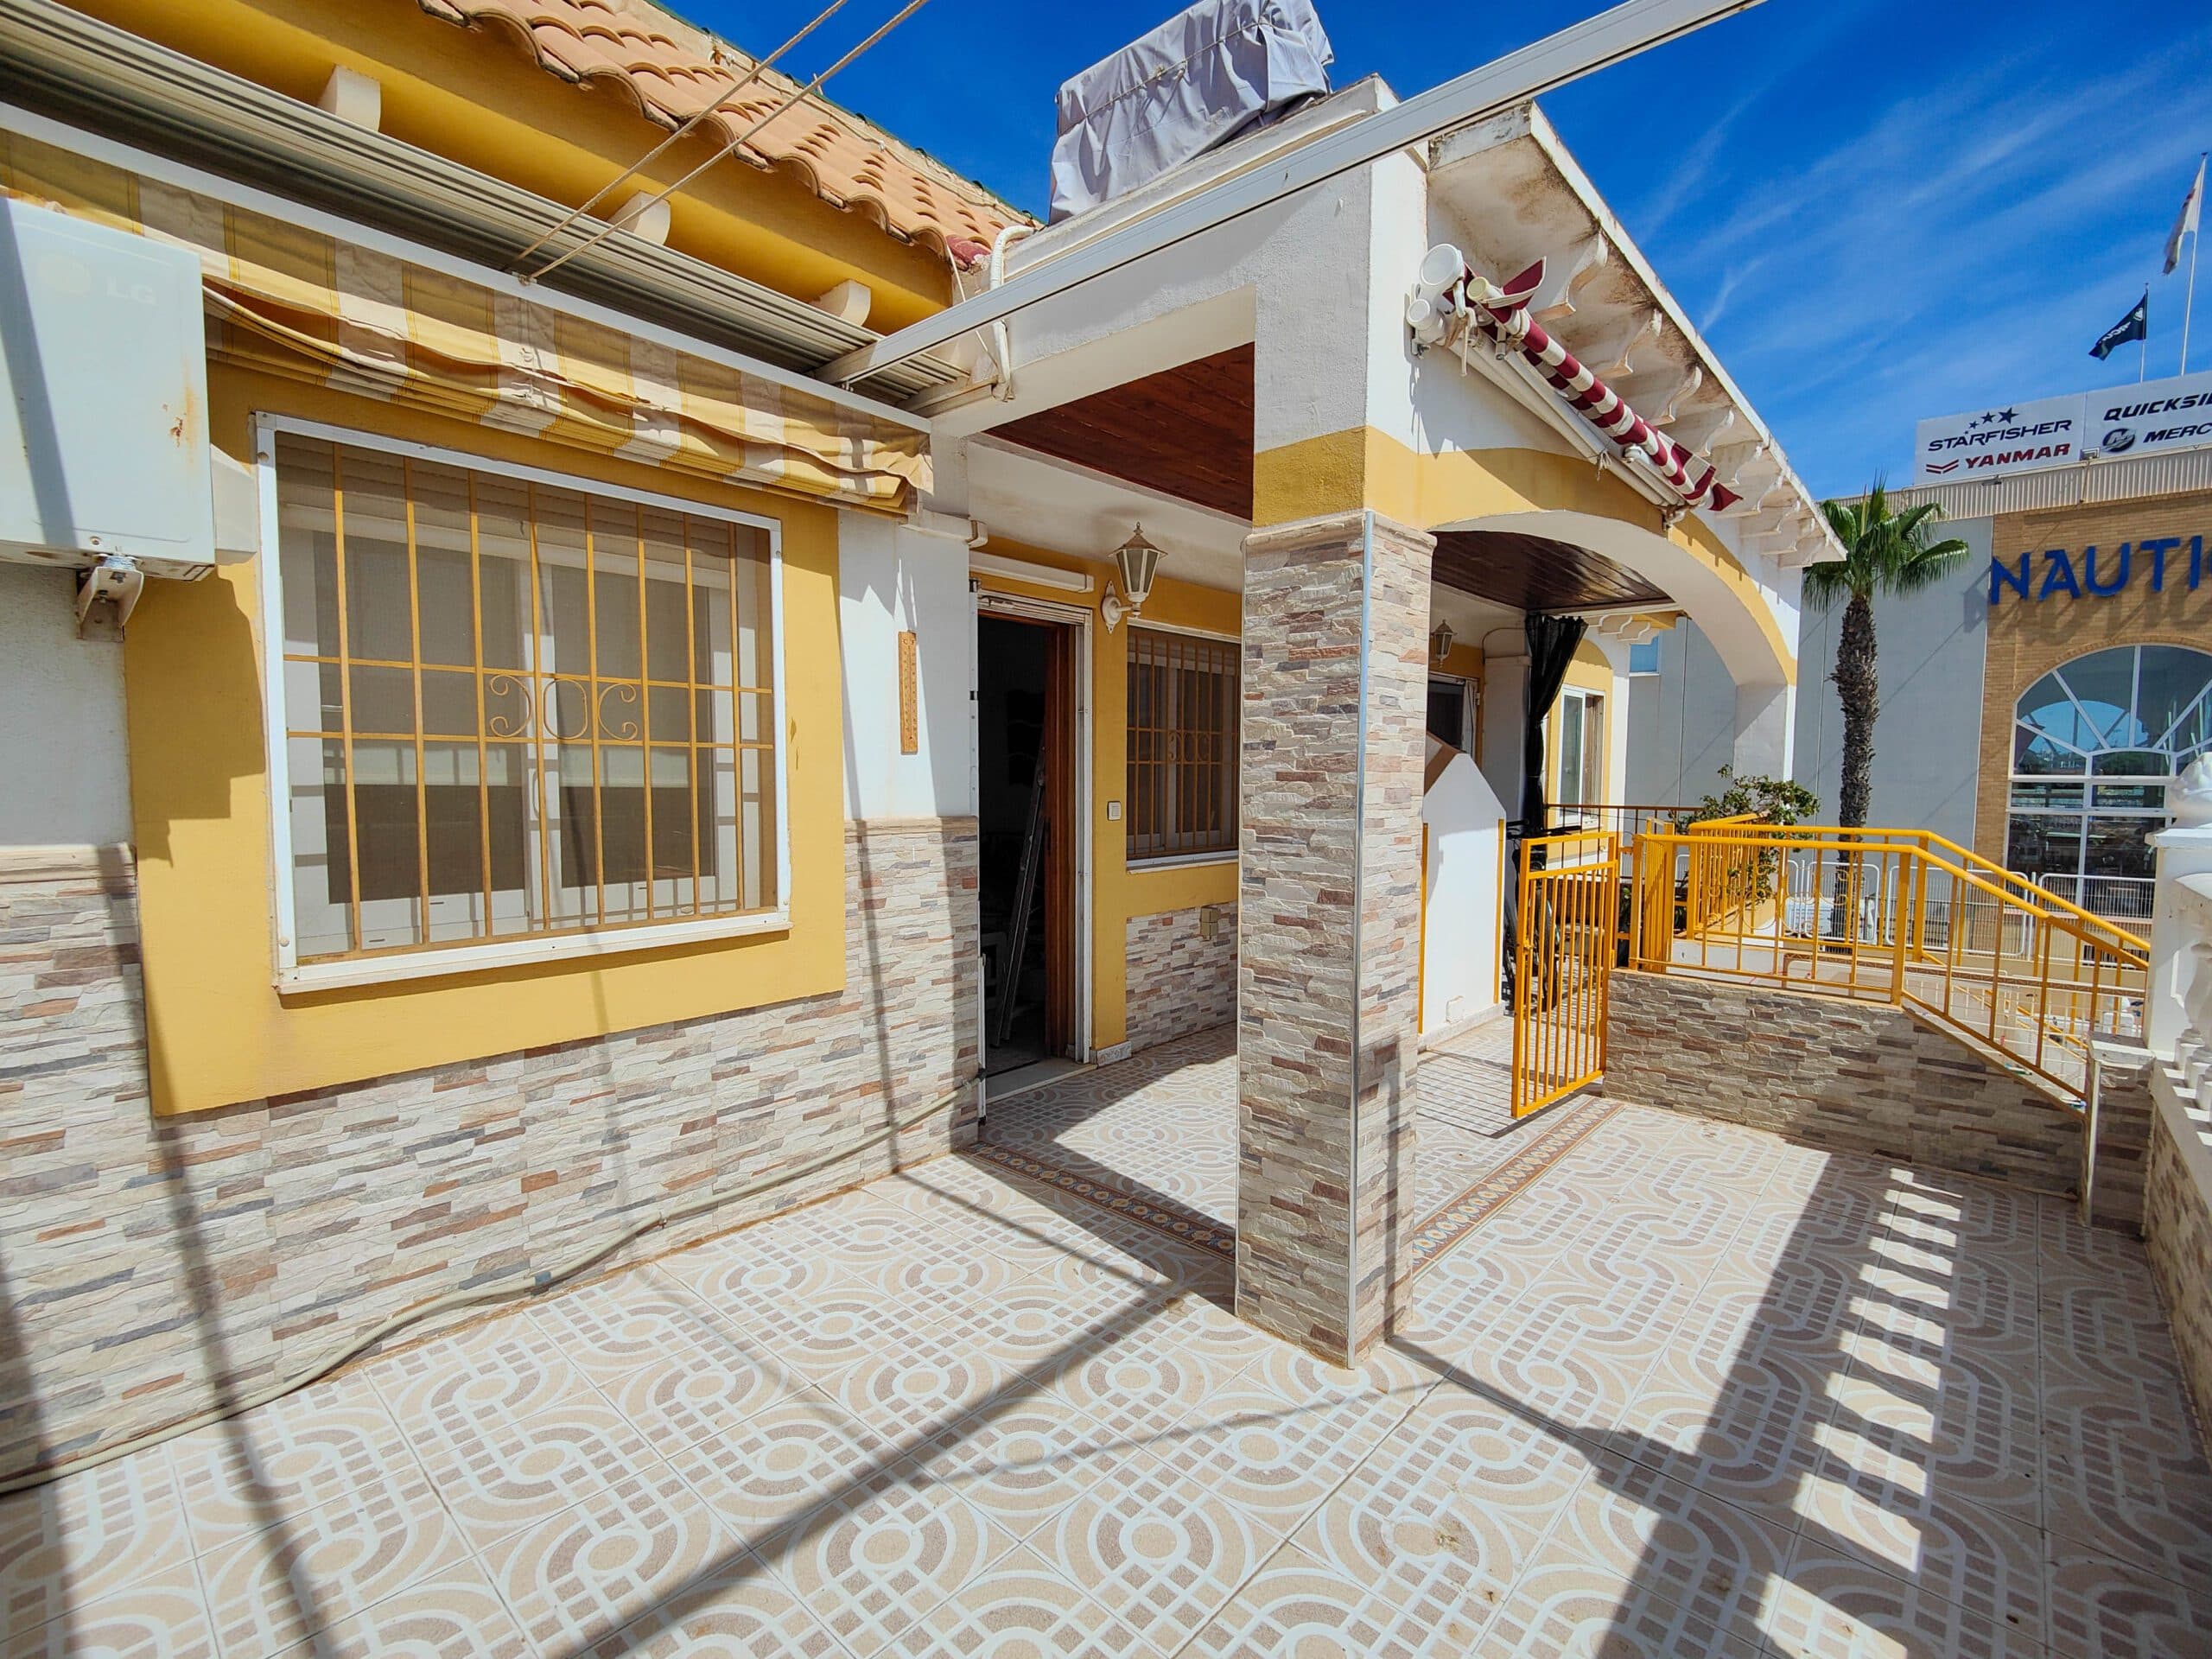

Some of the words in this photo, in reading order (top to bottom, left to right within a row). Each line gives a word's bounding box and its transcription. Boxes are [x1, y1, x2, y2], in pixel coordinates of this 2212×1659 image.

[107, 276, 156, 303] LG
[1928, 419, 2072, 452] STARFISHER
[1965, 442, 2070, 469] YANMAR
[1990, 535, 2212, 605] NAUTI
